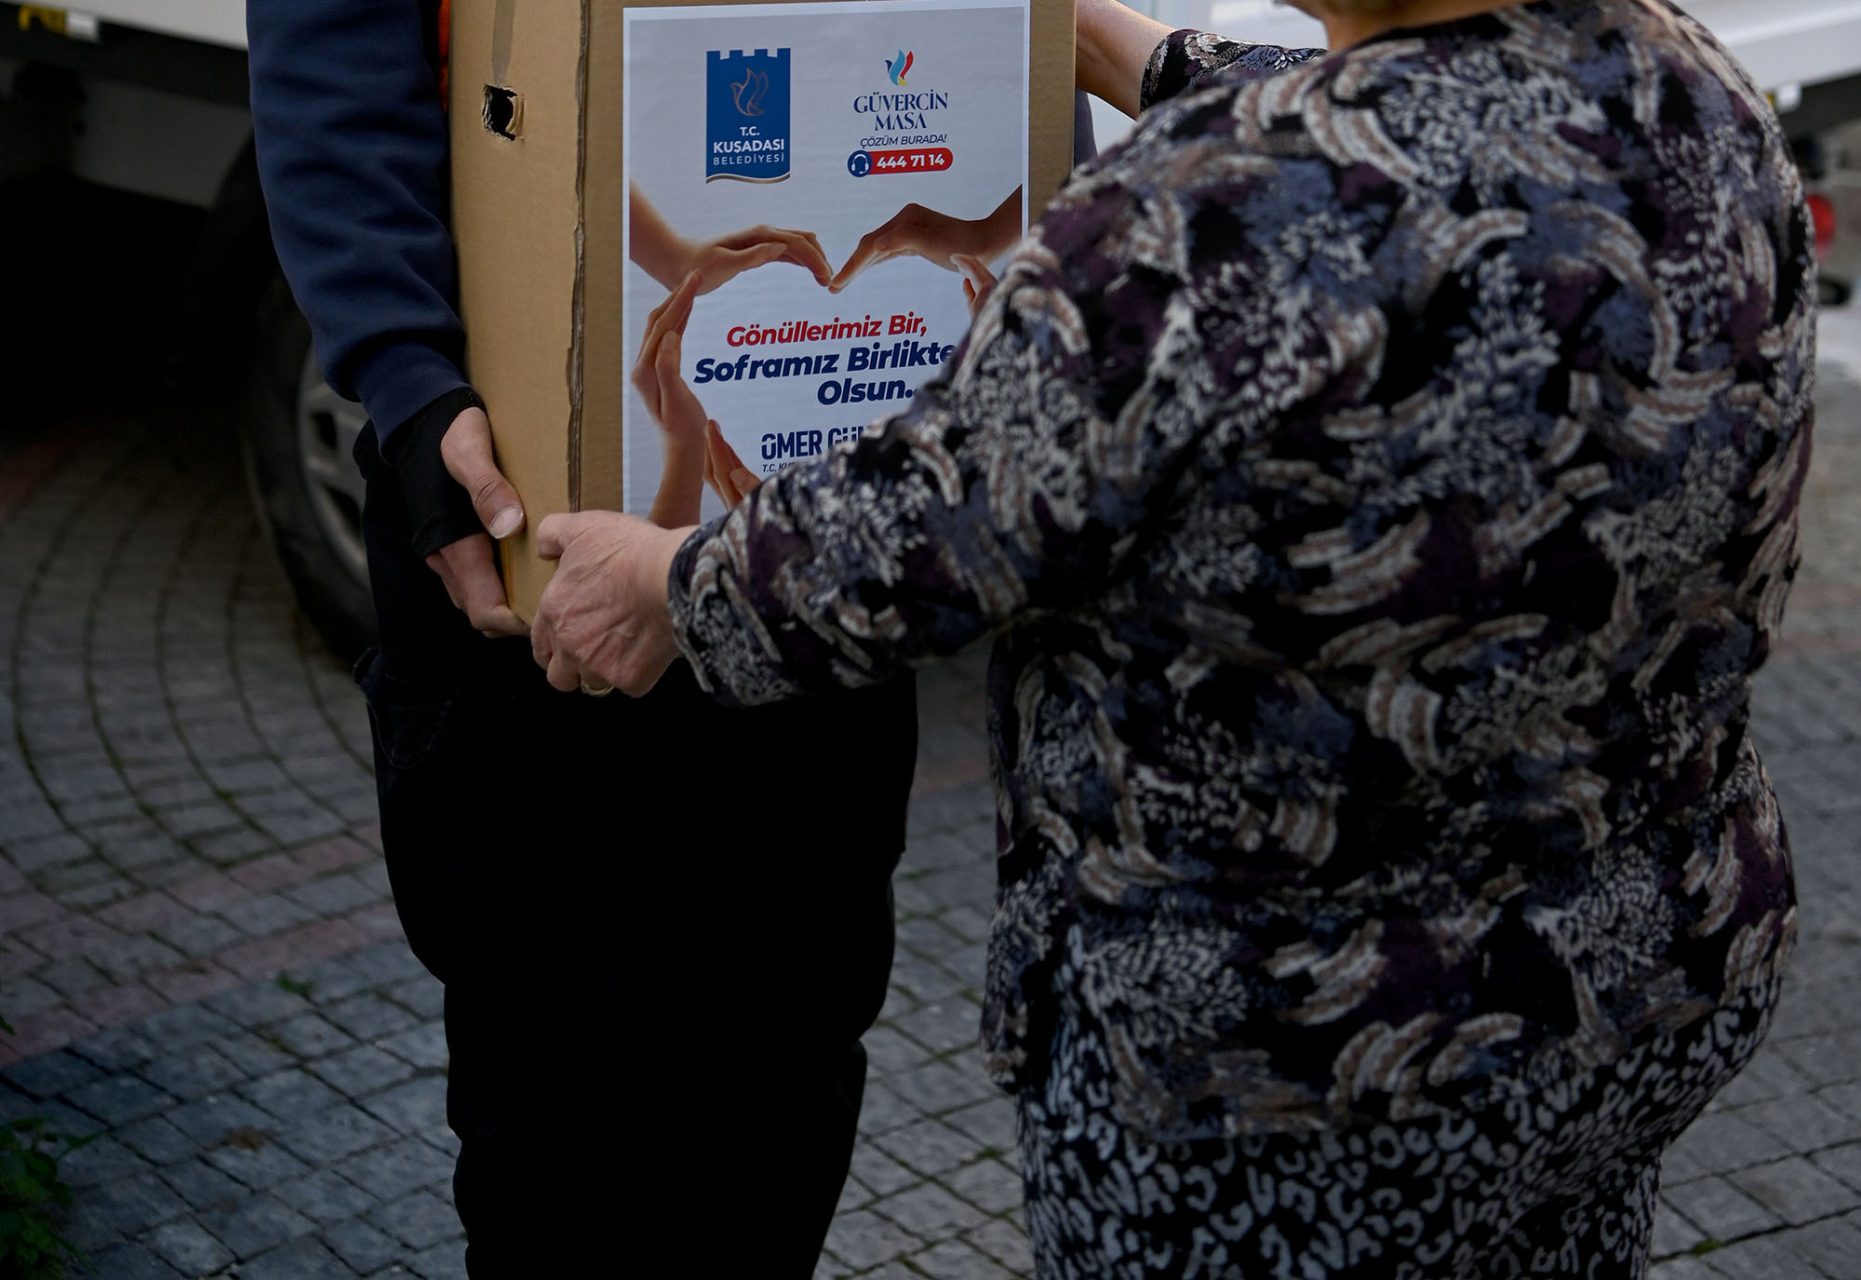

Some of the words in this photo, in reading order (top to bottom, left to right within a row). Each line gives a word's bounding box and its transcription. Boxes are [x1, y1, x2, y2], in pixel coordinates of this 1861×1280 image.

[853, 89, 948, 114] GÜVERCİN
[875, 112, 927, 131] MASA
[739, 126, 760, 136] T.C.
[713, 138, 785, 154] KUŞADASI
[860, 134, 898, 149] ÇÖZÜM
[901, 133, 948, 146] BURADA!
[713, 151, 785, 166] BELEDİYESİ
[876, 156, 907, 169] 444
[910, 154, 925, 167] 71
[929, 153, 945, 166] 14
[726, 314, 883, 348] Gönüllerimiz
[888, 311, 928, 337] Bir,
[693, 354, 840, 384] Soframız
[847, 339, 957, 372] Birlikte
